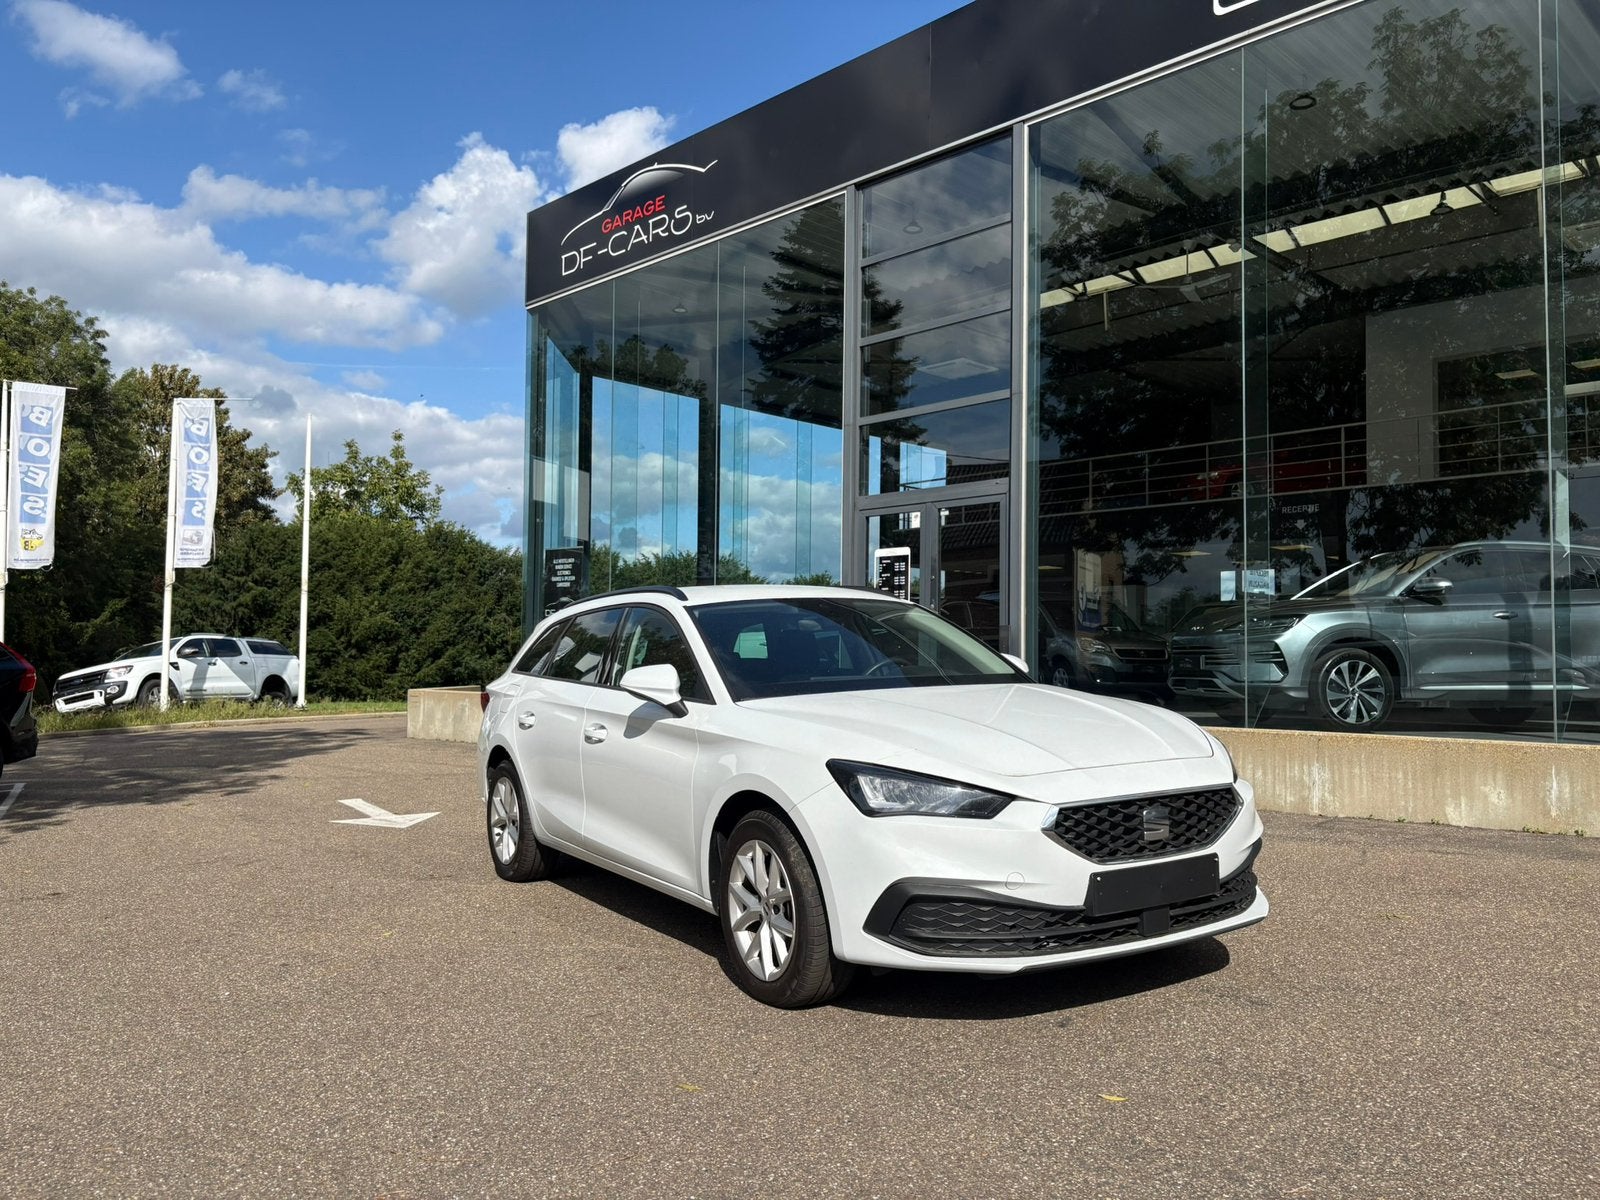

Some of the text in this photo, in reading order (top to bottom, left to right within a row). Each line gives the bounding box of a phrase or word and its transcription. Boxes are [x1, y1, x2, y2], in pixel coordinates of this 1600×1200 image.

[602, 195, 666, 233] GARAGE
[561, 205, 692, 276] DF-CARS
[1282, 504, 1320, 514] RECEPTIE
